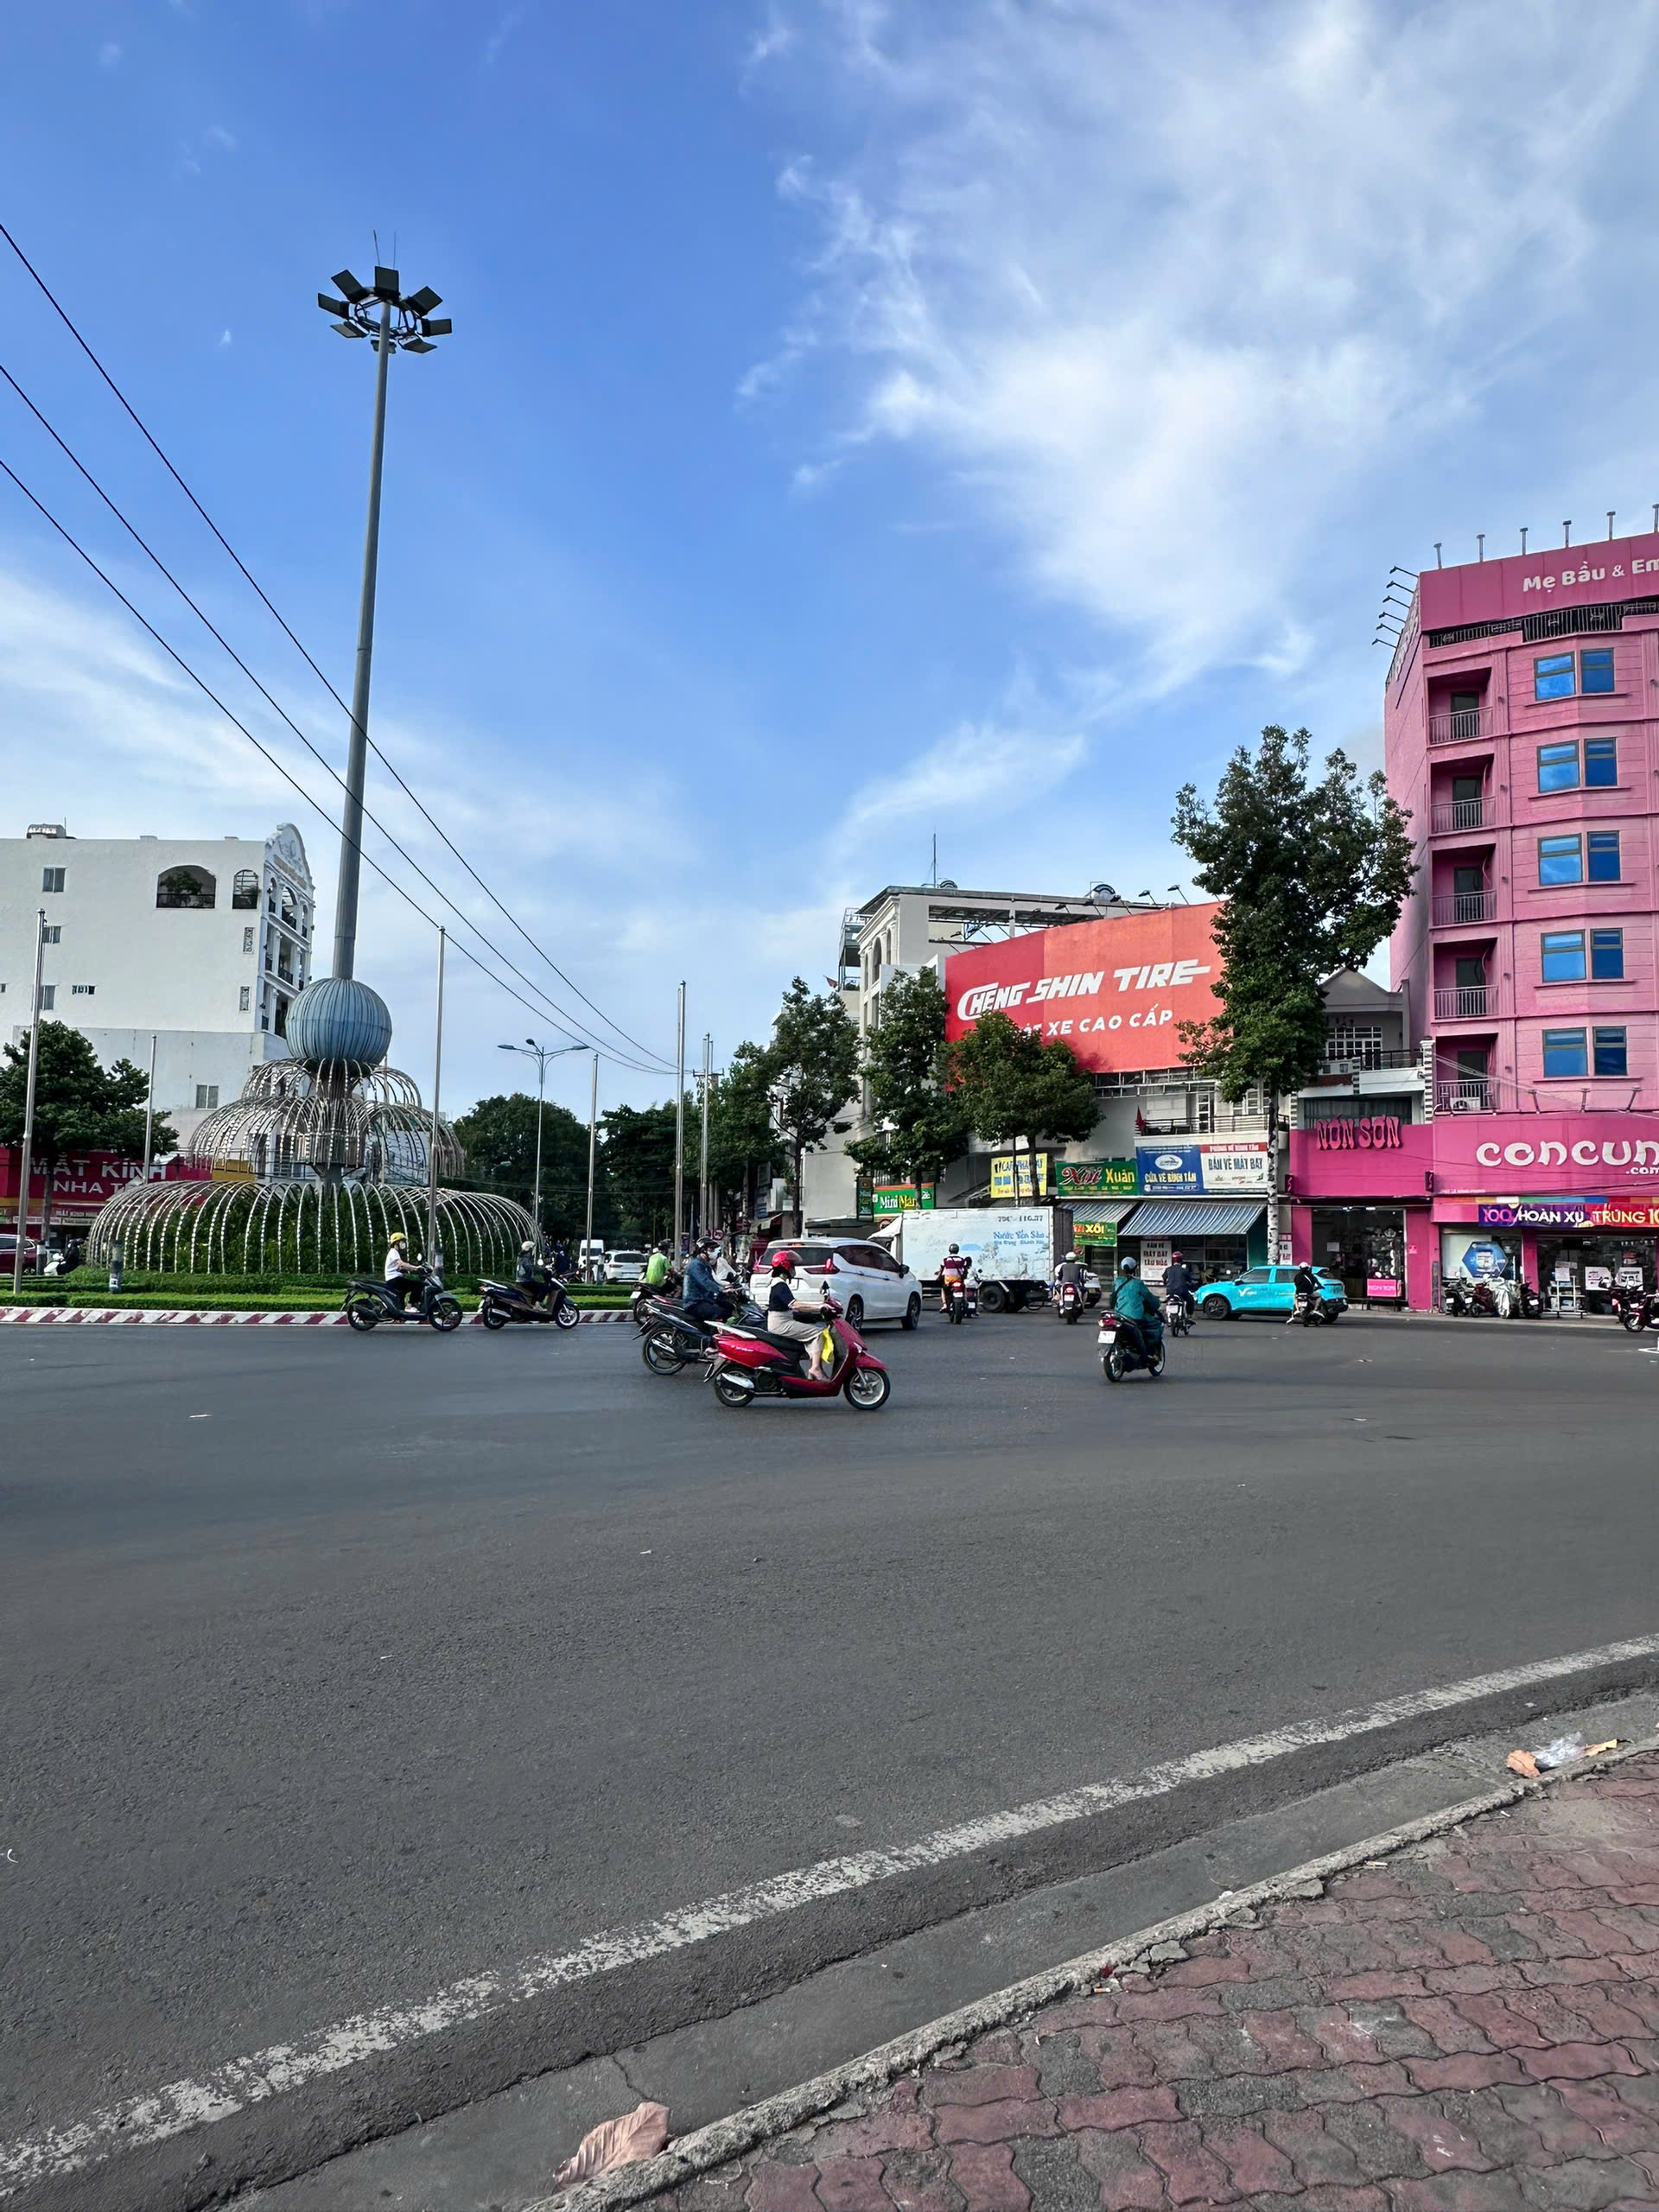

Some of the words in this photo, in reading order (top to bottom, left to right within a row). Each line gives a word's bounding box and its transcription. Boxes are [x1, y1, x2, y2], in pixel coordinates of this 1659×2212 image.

[1522, 575, 1555, 593] Mẹ
[1561, 561, 1605, 586] Bầu
[1611, 564, 1625, 577] &
[957, 982, 1031, 1020] CHENG
[1026, 971, 1104, 1003] SHIN
[1113, 959, 1211, 992] TIRE
[1046, 1020, 1073, 1037] XE
[1079, 1015, 1122, 1033] CAO
[1129, 1003, 1173, 1027] CẤP
[1106, 1168, 1135, 1183] Xuân
[54, 1179, 104, 1194] NHA
[880, 1195, 899, 1209] Mini
[899, 1195, 918, 1209] Mar
[1517, 1208, 1560, 1223] HOÀN
